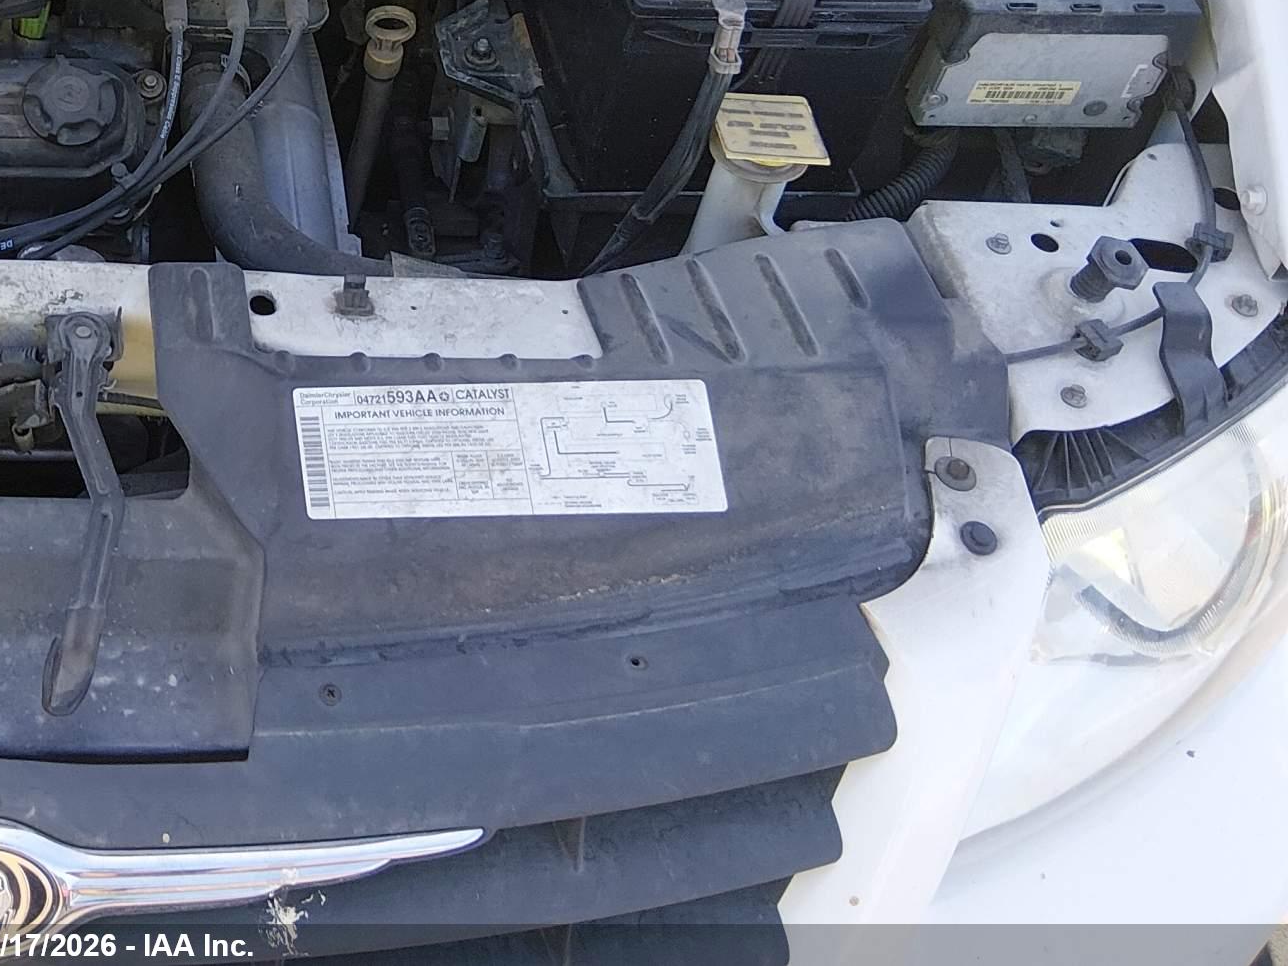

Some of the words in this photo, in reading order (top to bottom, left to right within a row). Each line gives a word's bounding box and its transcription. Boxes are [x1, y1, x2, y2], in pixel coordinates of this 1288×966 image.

[299, 391, 351, 399] DaimlerChrysler
[356, 390, 438, 405] 04721593AA
[455, 388, 511, 400] CATALYST
[300, 398, 339, 406] Corporation
[334, 409, 391, 420] IMPORTANT
[393, 408, 433, 418] VEHICLE
[435, 407, 505, 417] INFORMATION
